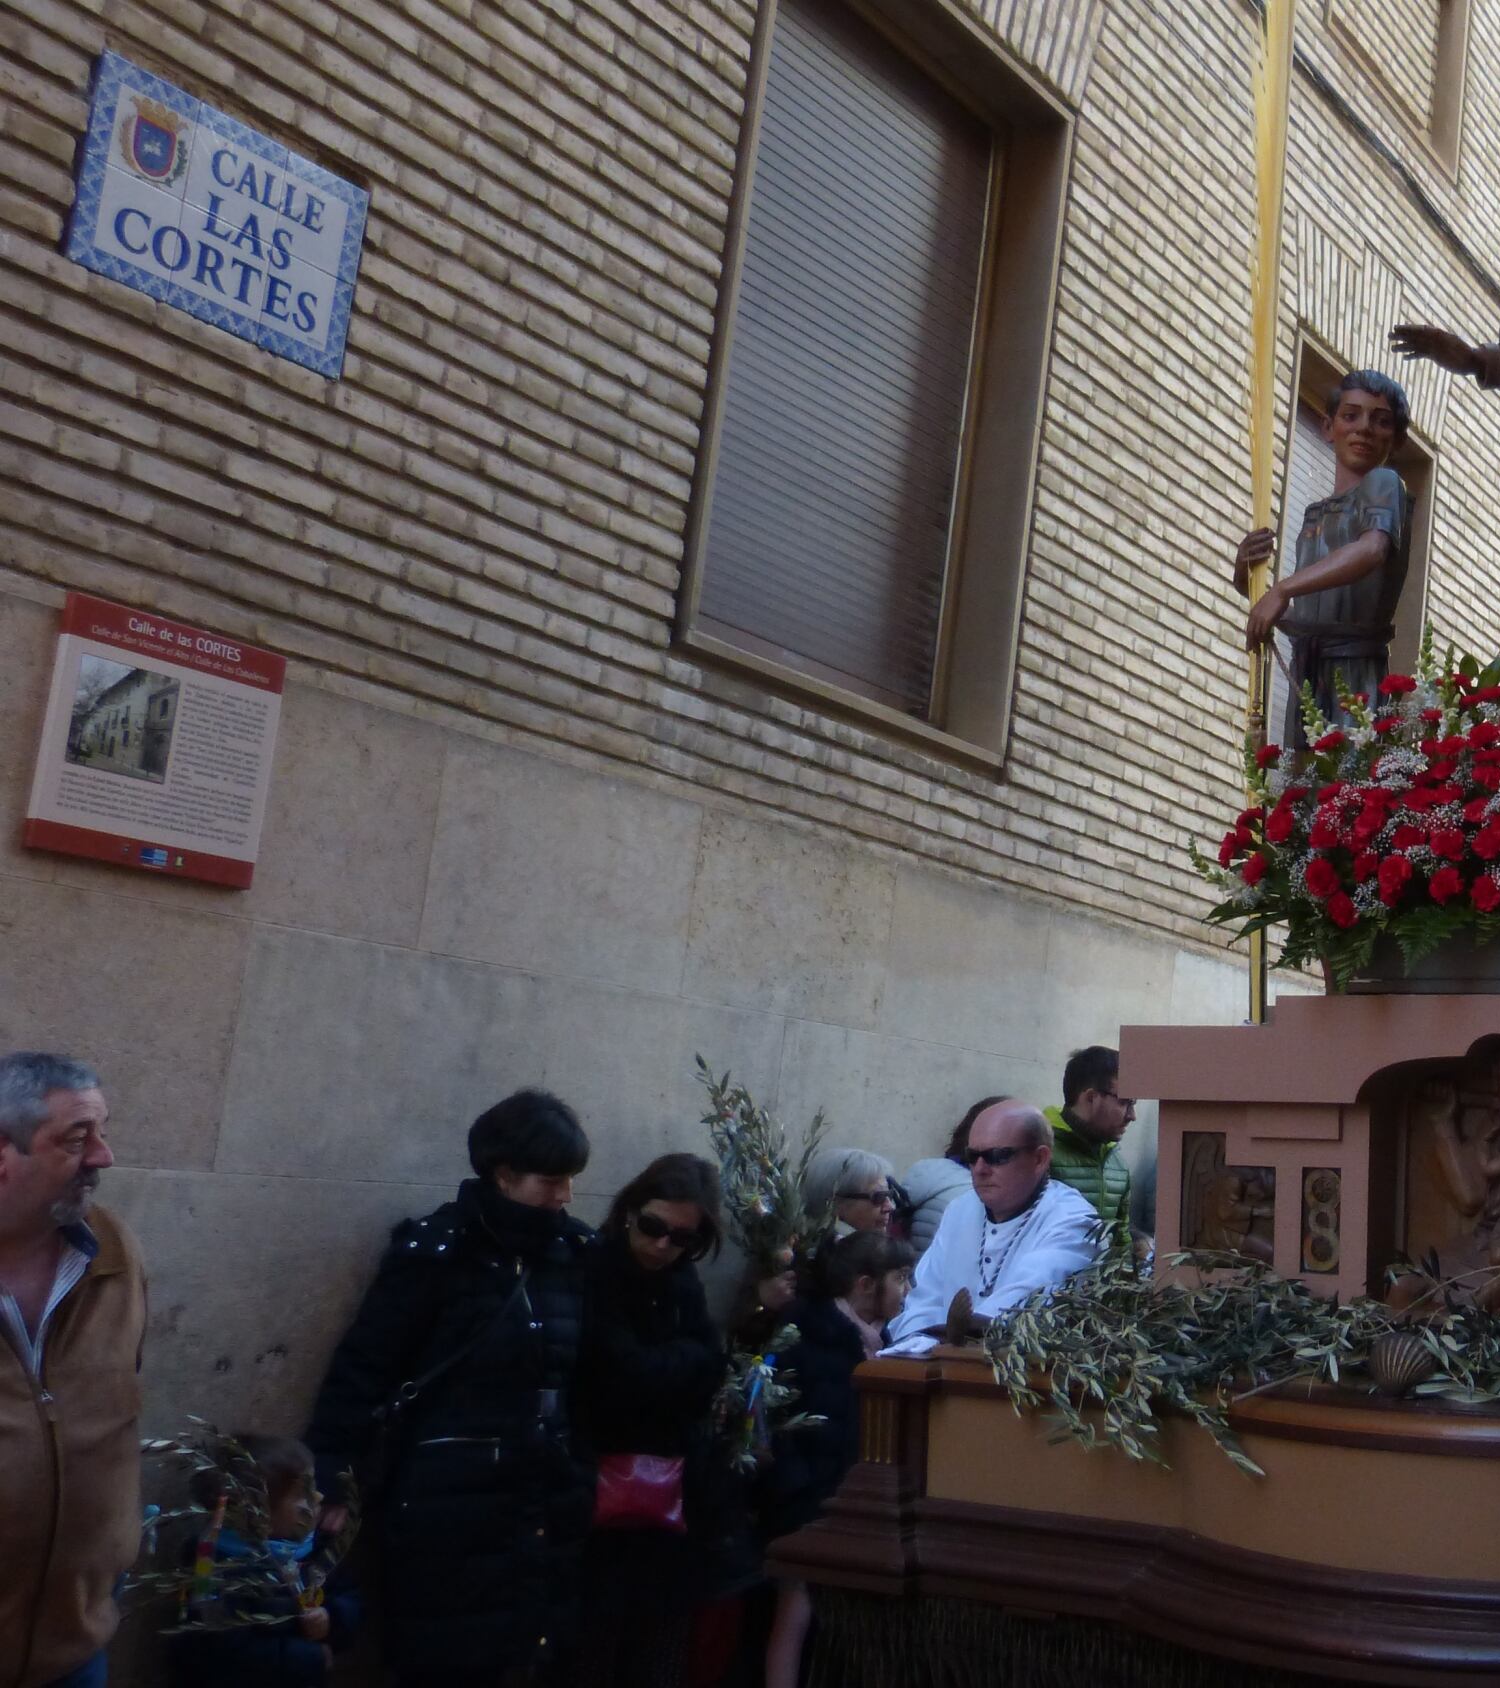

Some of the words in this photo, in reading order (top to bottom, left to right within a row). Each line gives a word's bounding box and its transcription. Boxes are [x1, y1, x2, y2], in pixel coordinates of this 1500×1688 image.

[203, 191, 293, 270] LAS
[211, 149, 325, 234] CALLE
[114, 208, 318, 333] CORTES
[128, 617, 156, 637] Calle
[160, 628, 174, 641] de
[177, 632, 192, 647] las
[196, 637, 241, 662] CORTES
